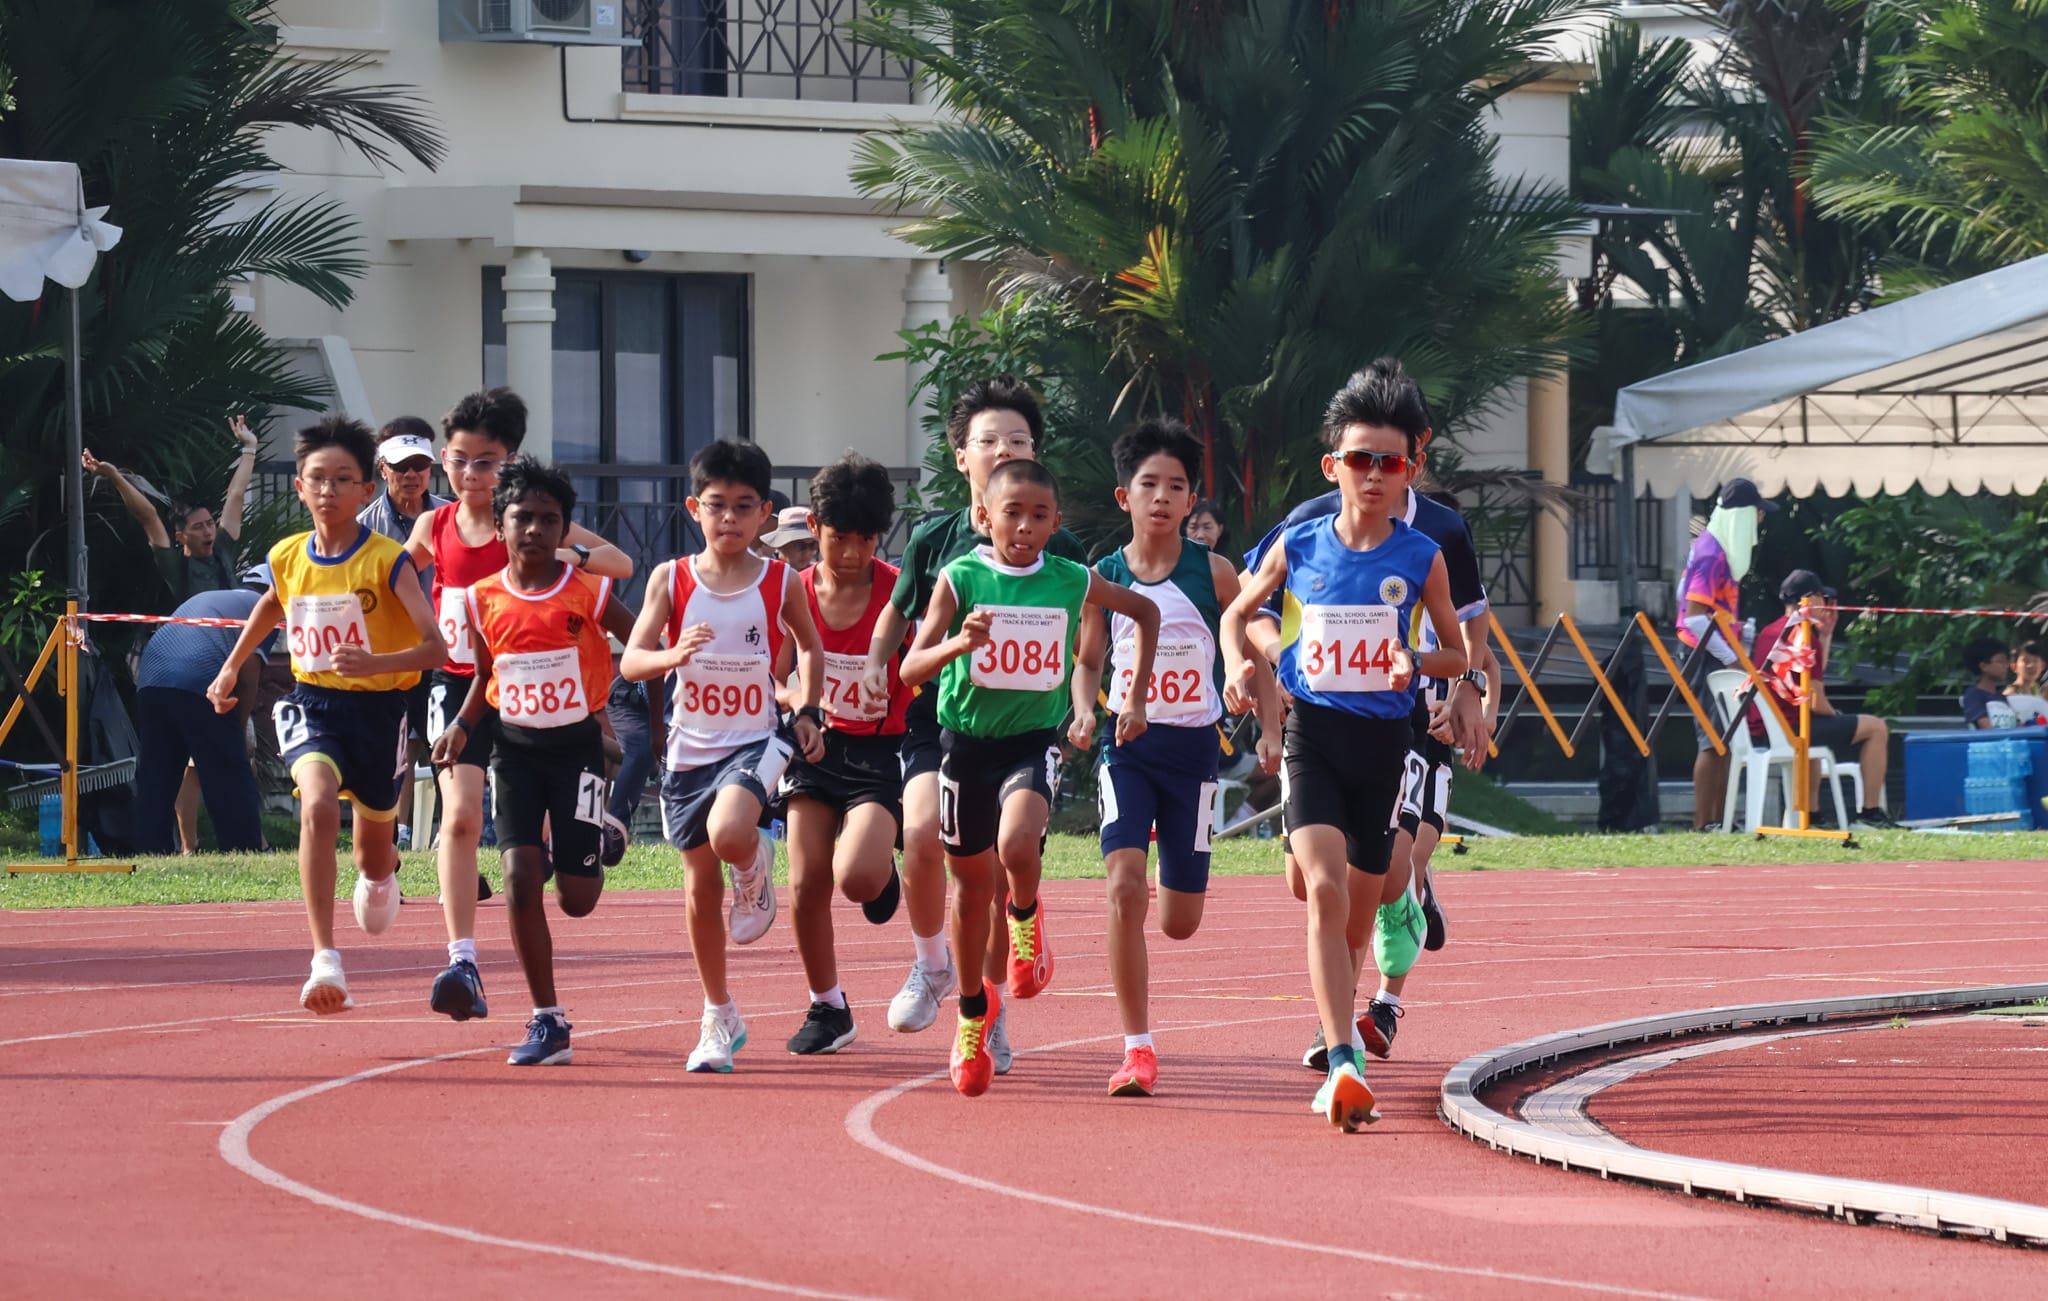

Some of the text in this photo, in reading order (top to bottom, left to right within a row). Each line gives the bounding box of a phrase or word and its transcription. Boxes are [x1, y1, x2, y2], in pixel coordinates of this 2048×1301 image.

[292, 621, 364, 658] 3004
[977, 639, 1061, 675] 3084
[1306, 638, 1393, 676] 3144
[505, 677, 581, 717] 3582
[684, 680, 762, 717] 3690
[281, 704, 303, 744] 2
[583, 778, 603, 825] 11
